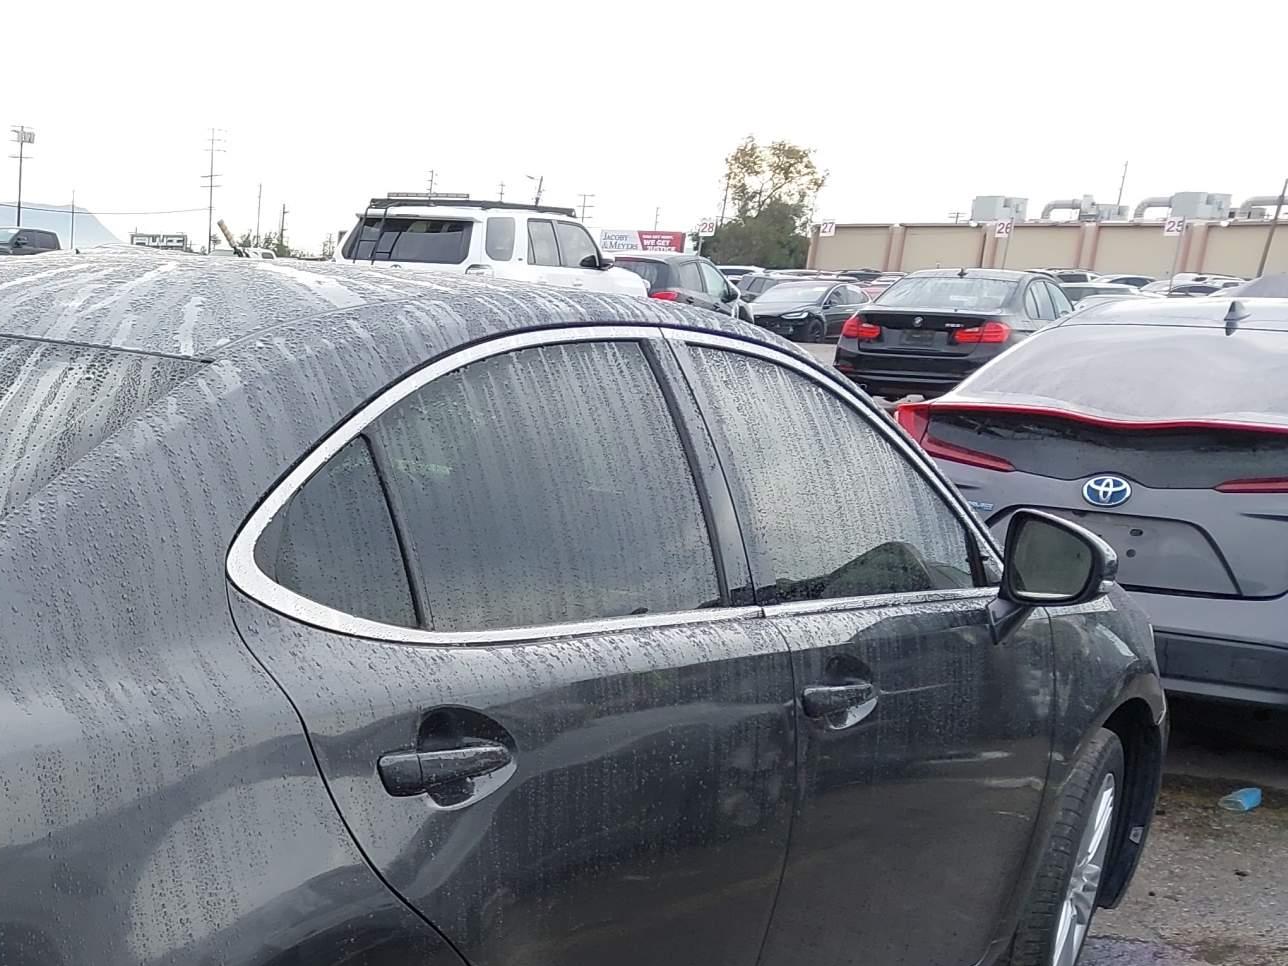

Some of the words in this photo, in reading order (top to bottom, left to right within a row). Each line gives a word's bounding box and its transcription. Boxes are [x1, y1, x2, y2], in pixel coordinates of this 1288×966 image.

[701, 222, 715, 233] 28
[822, 222, 835, 233] 27
[997, 222, 1011, 234] 26
[1167, 220, 1183, 232] 25
